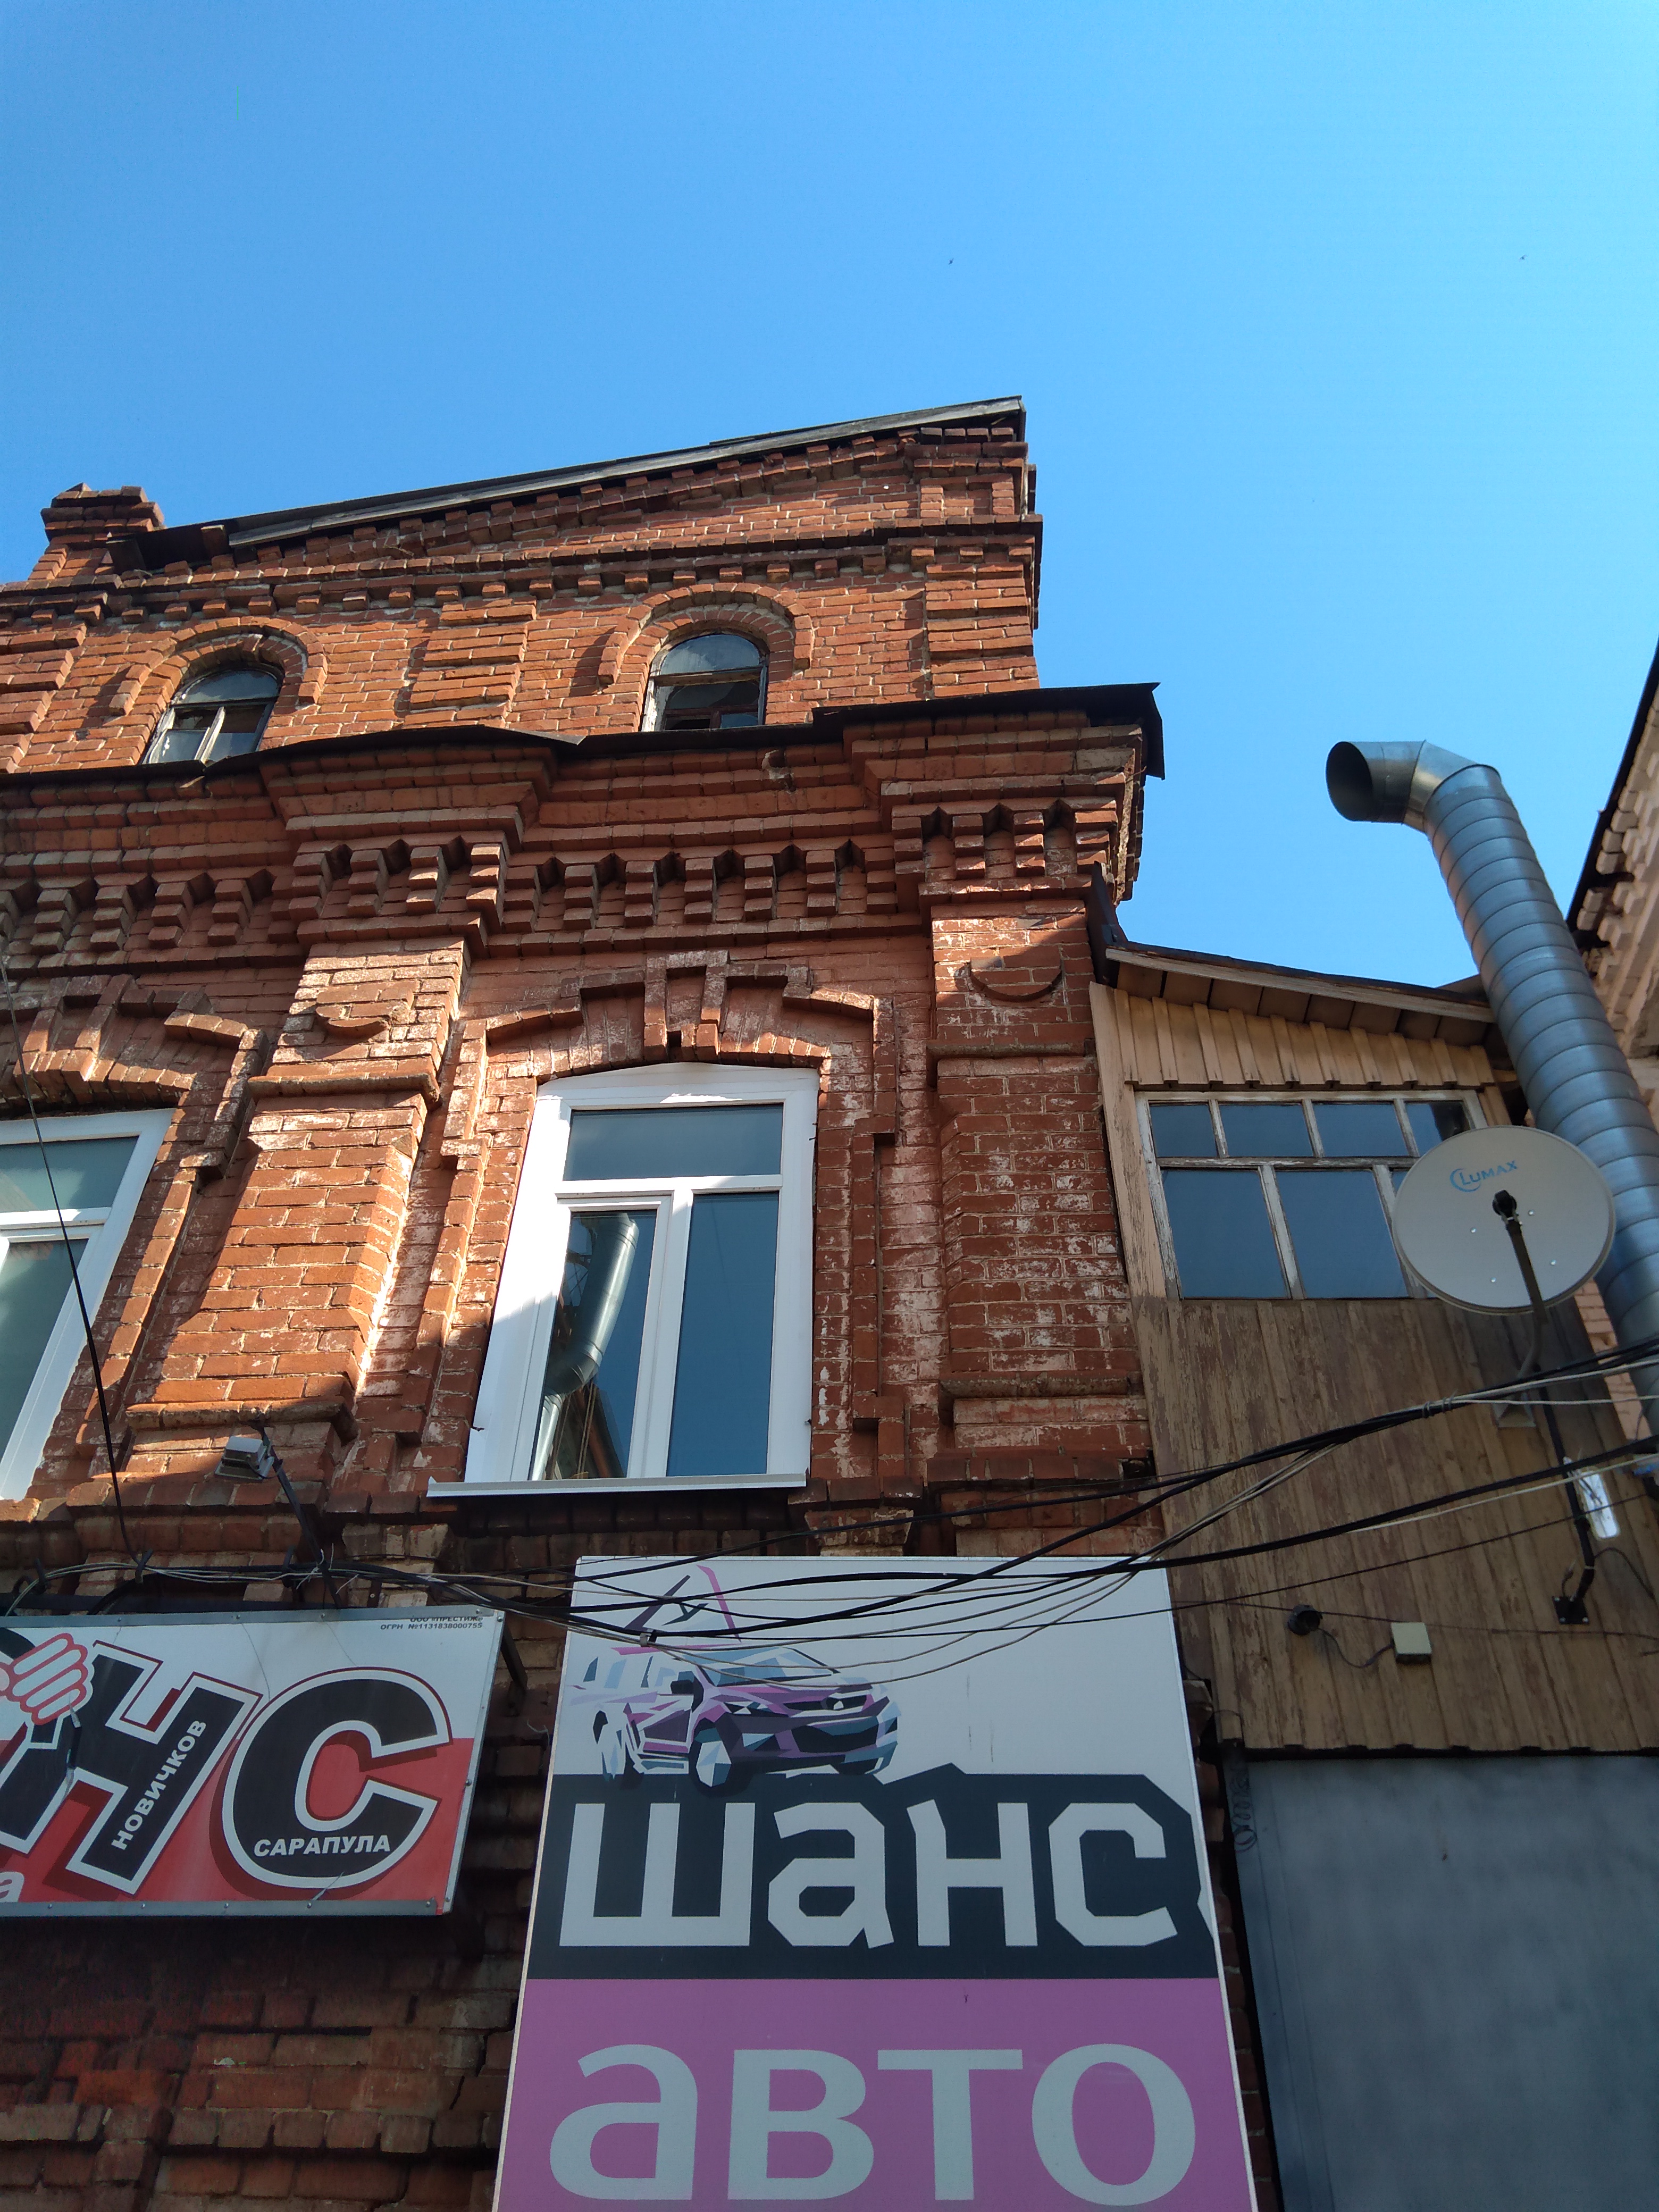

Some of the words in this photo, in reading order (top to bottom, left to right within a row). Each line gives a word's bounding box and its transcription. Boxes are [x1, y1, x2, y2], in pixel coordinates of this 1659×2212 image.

[1459, 1160, 1518, 1186] LUMAX
[111, 1720, 207, 1850] НОВИЧКОВ
[253, 1834, 391, 1858] САРАПУЛА
[549, 2043, 1196, 2206] авто
